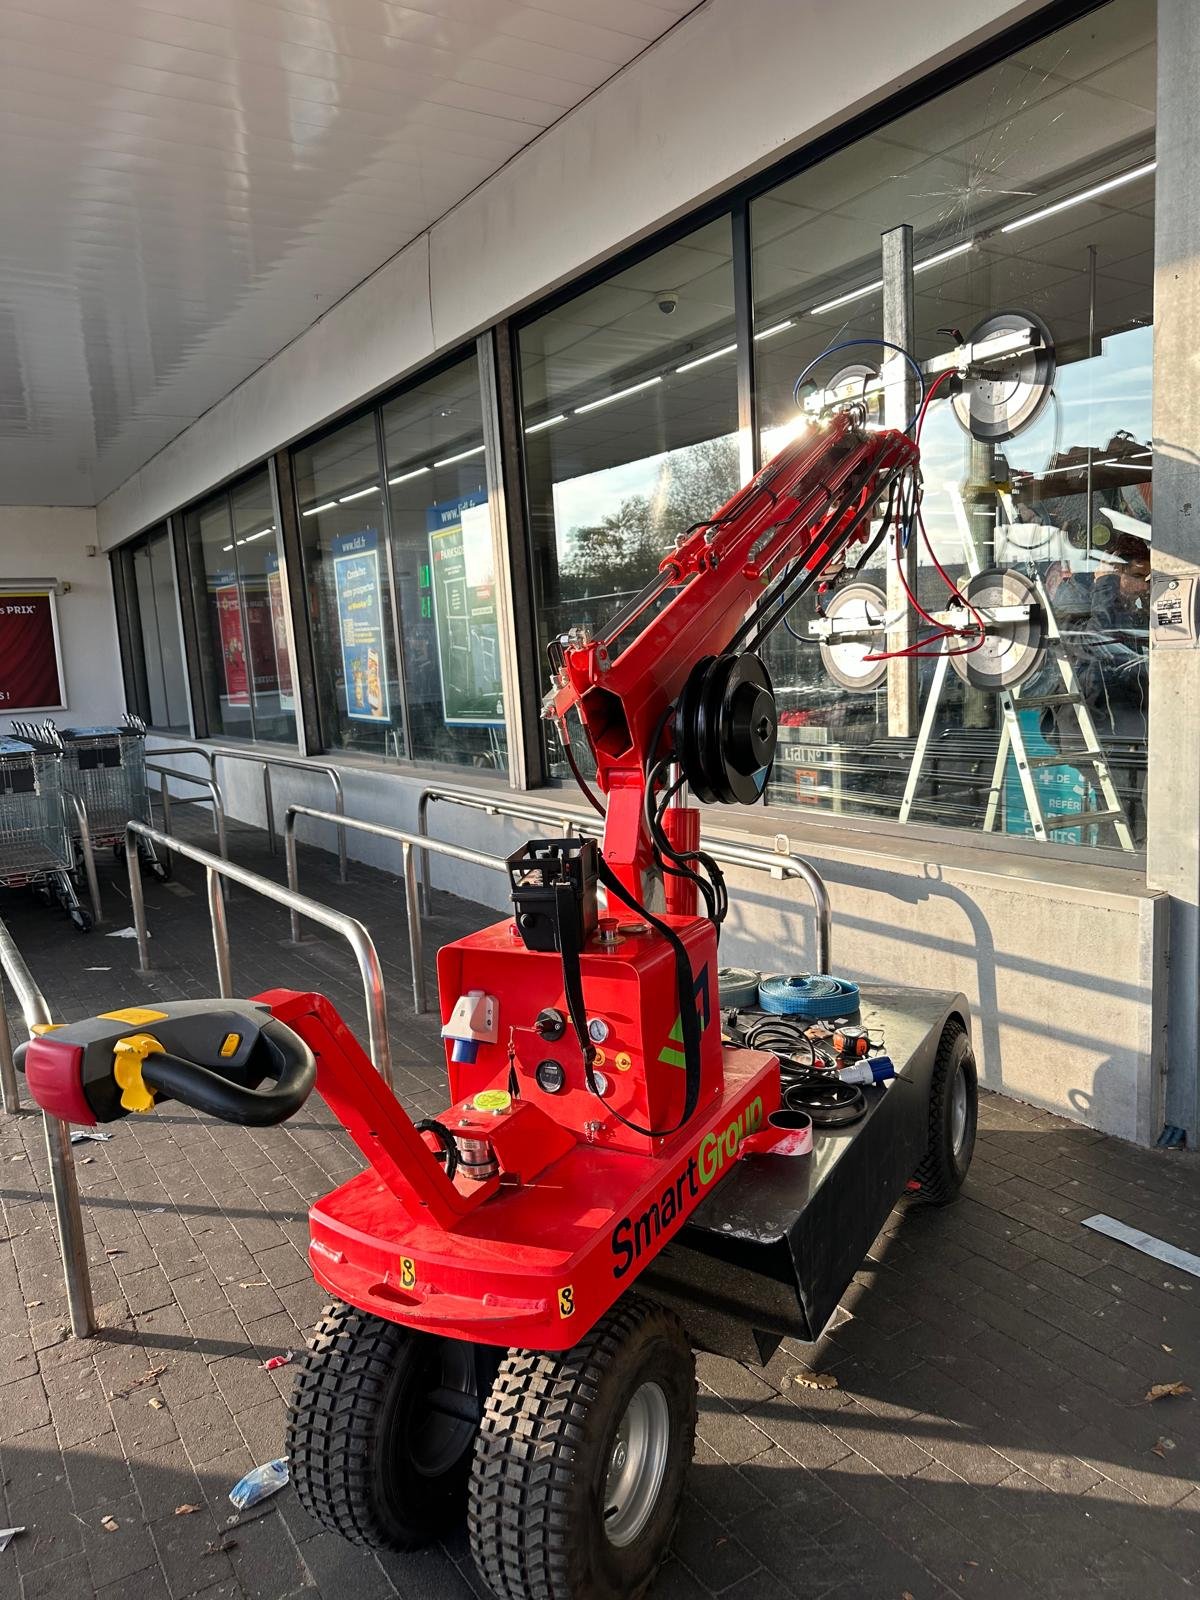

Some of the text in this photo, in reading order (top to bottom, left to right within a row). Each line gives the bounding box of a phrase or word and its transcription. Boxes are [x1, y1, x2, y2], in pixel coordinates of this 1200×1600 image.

[440, 544, 465, 560] PARKSID
[784, 747, 805, 762] Lidl
[1056, 774, 1071, 784] DE
[1048, 796, 1082, 811] RÉFÉR
